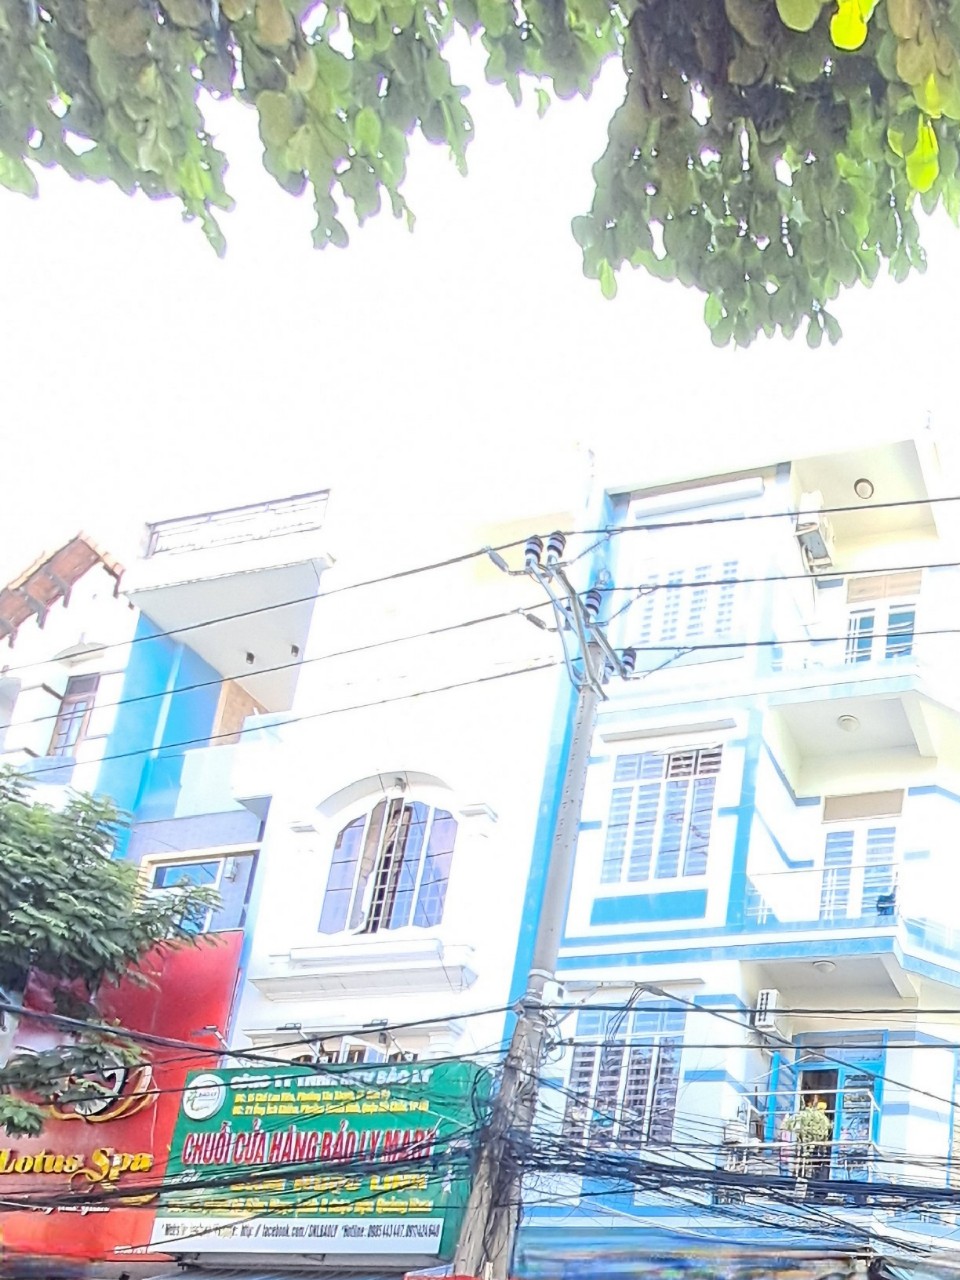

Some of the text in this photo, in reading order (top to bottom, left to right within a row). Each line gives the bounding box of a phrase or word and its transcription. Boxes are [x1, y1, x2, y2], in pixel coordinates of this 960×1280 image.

[182, 1121, 234, 1165] CHUỖI
[233, 1119, 269, 1164] CỬA
[268, 1125, 319, 1163] HÀNG
[320, 1119, 358, 1160] BẢO
[70, 1147, 154, 1192] Spa
